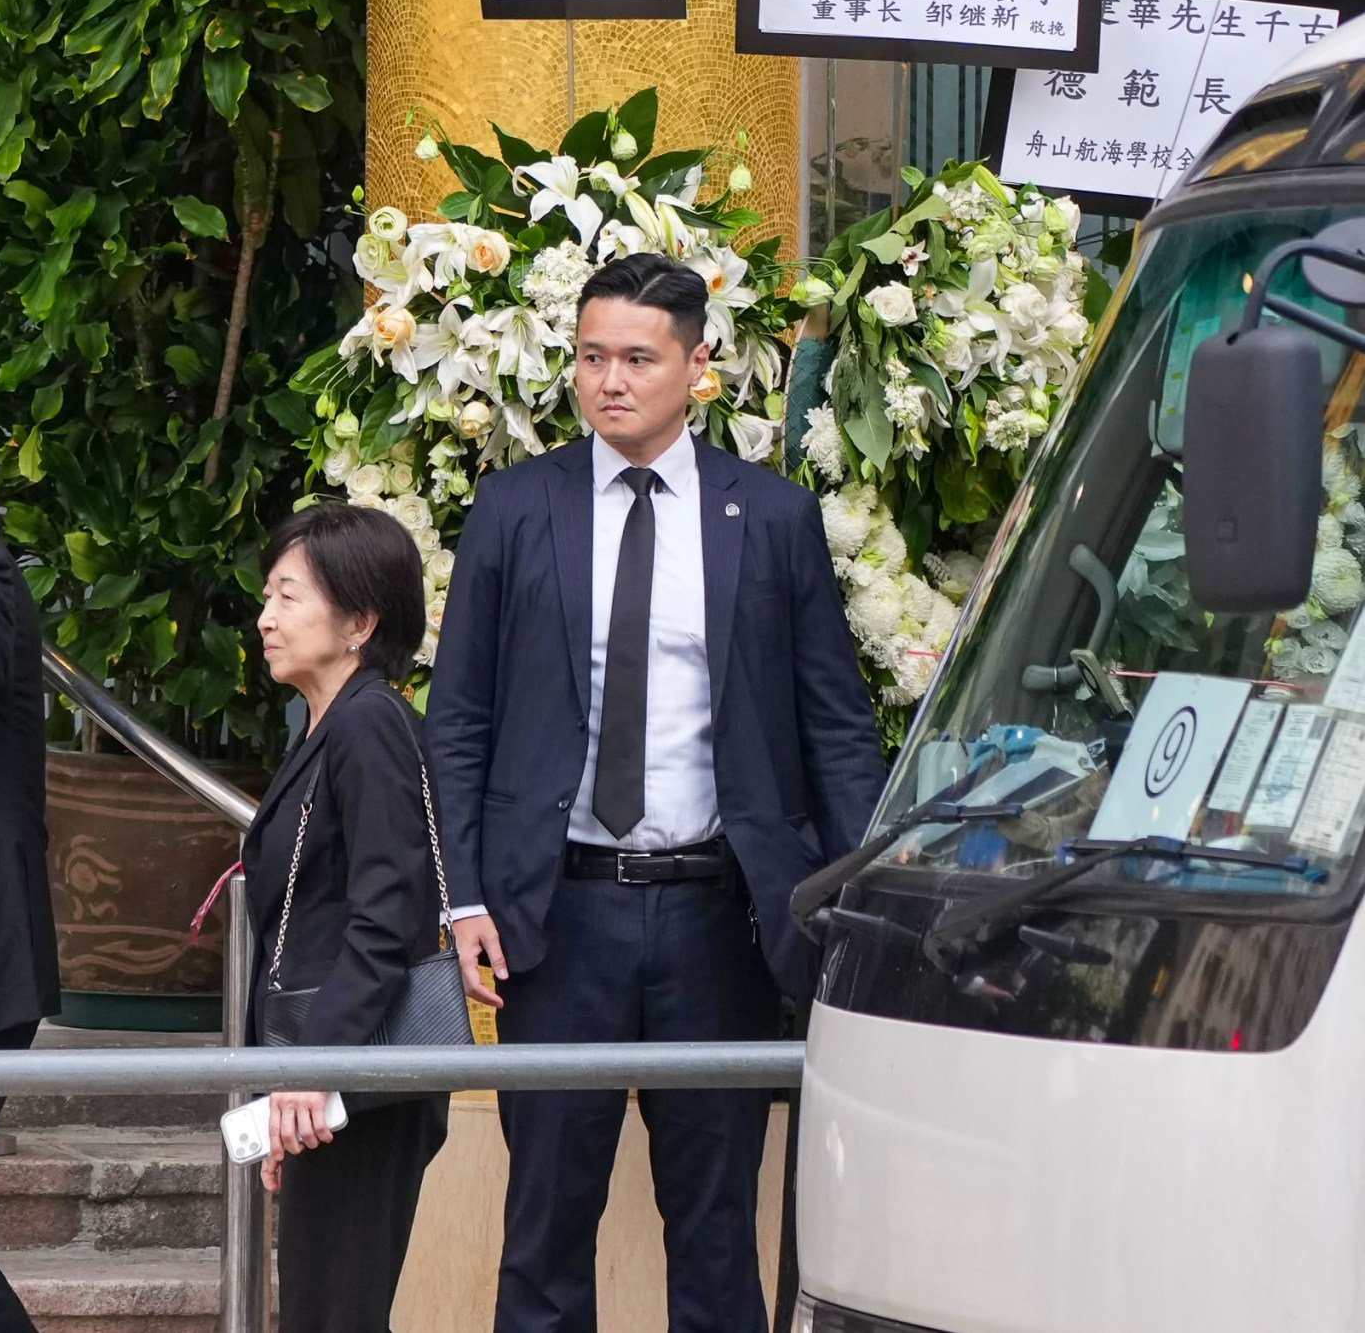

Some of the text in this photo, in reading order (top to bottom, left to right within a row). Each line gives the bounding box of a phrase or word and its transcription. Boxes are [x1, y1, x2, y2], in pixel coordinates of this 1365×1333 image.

[925, 0, 1021, 31] 邹继新
[1029, 20, 1066, 37] 敬挽
